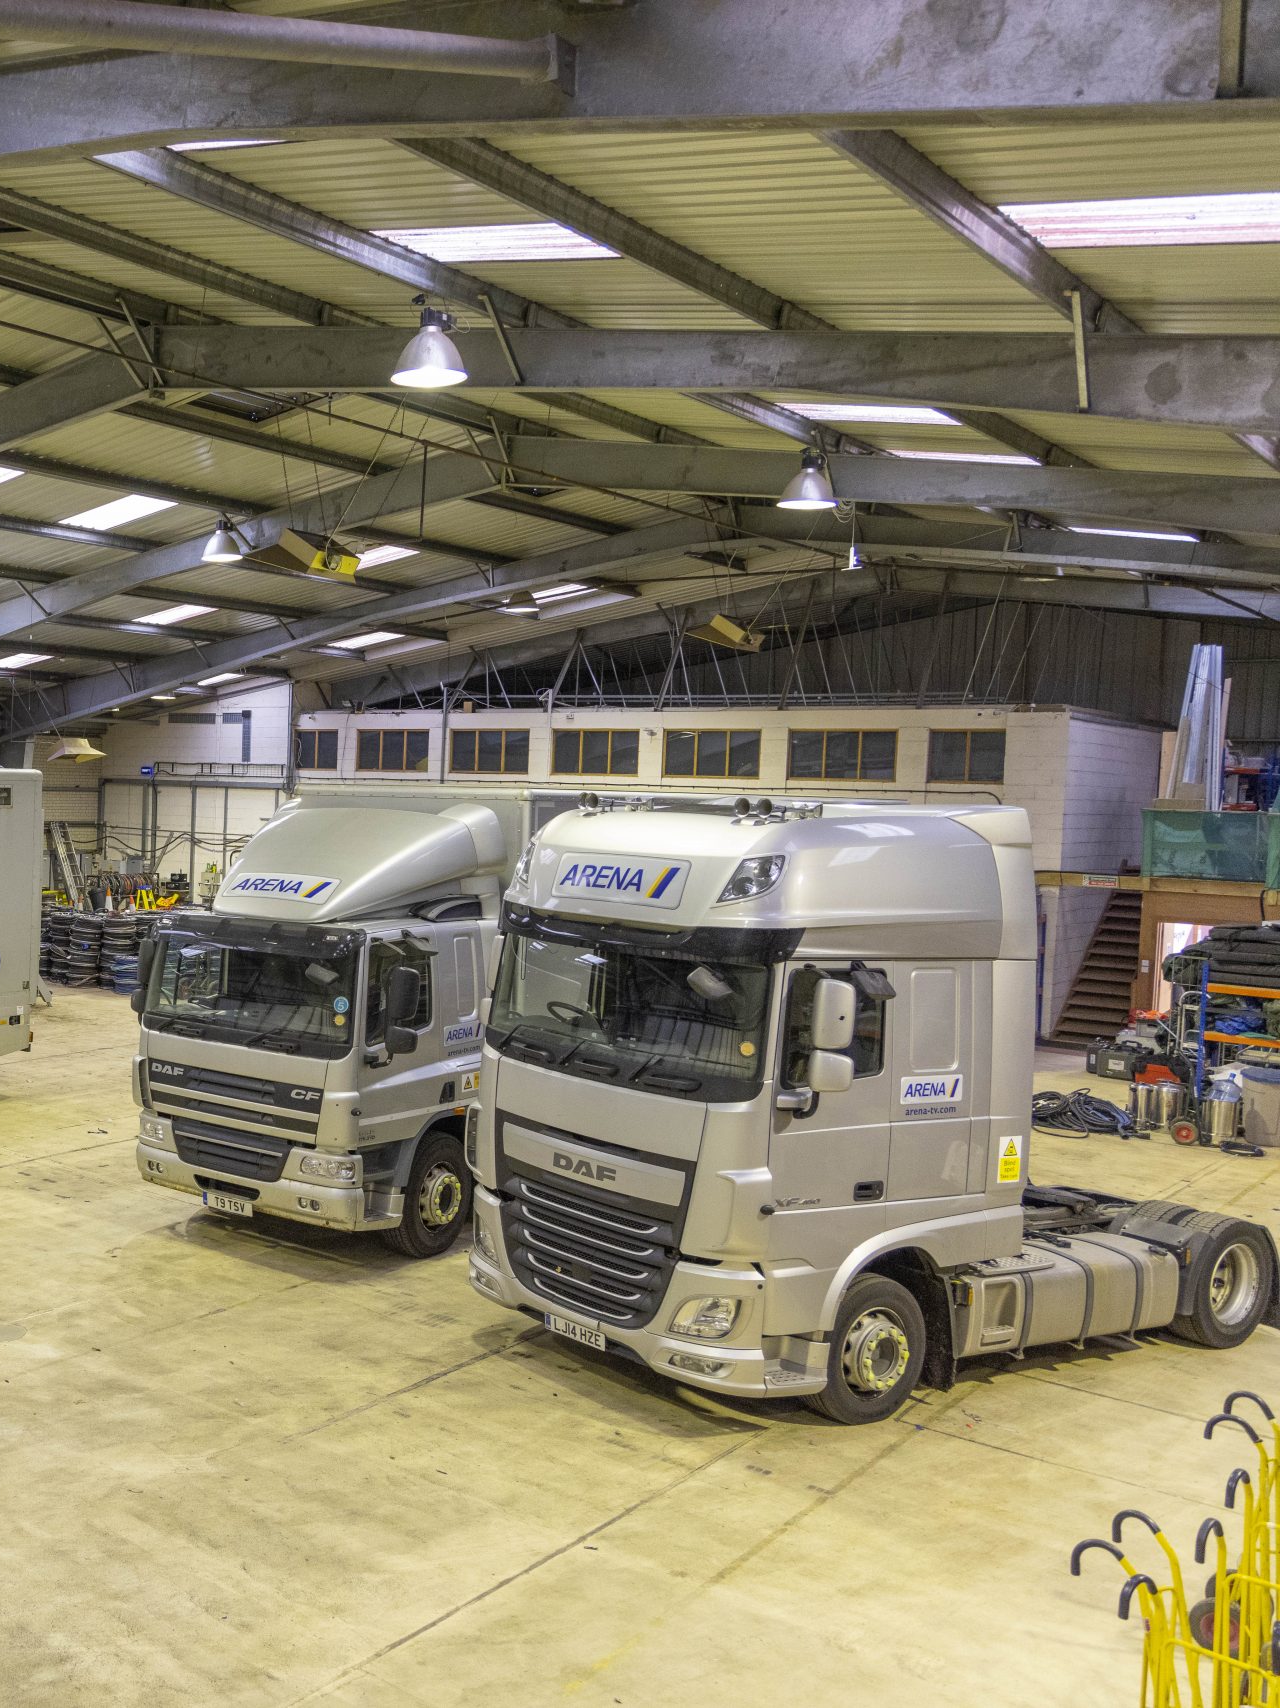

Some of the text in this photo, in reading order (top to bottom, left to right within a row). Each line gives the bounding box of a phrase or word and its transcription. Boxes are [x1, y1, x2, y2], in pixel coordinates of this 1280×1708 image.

[231, 877, 304, 894] ARENA
[559, 863, 644, 892] ARENA
[446, 1026, 474, 1042] ARENA
[151, 1062, 184, 1076] DAF
[290, 1088, 321, 1101] CF
[904, 1082, 946, 1098] ARENA
[905, 1106, 957, 1116] arena-tv.com
[552, 1151, 617, 1182] DAF
[214, 1196, 245, 1213] T9 TSV
[553, 1317, 601, 1348] LJ14 HZE
